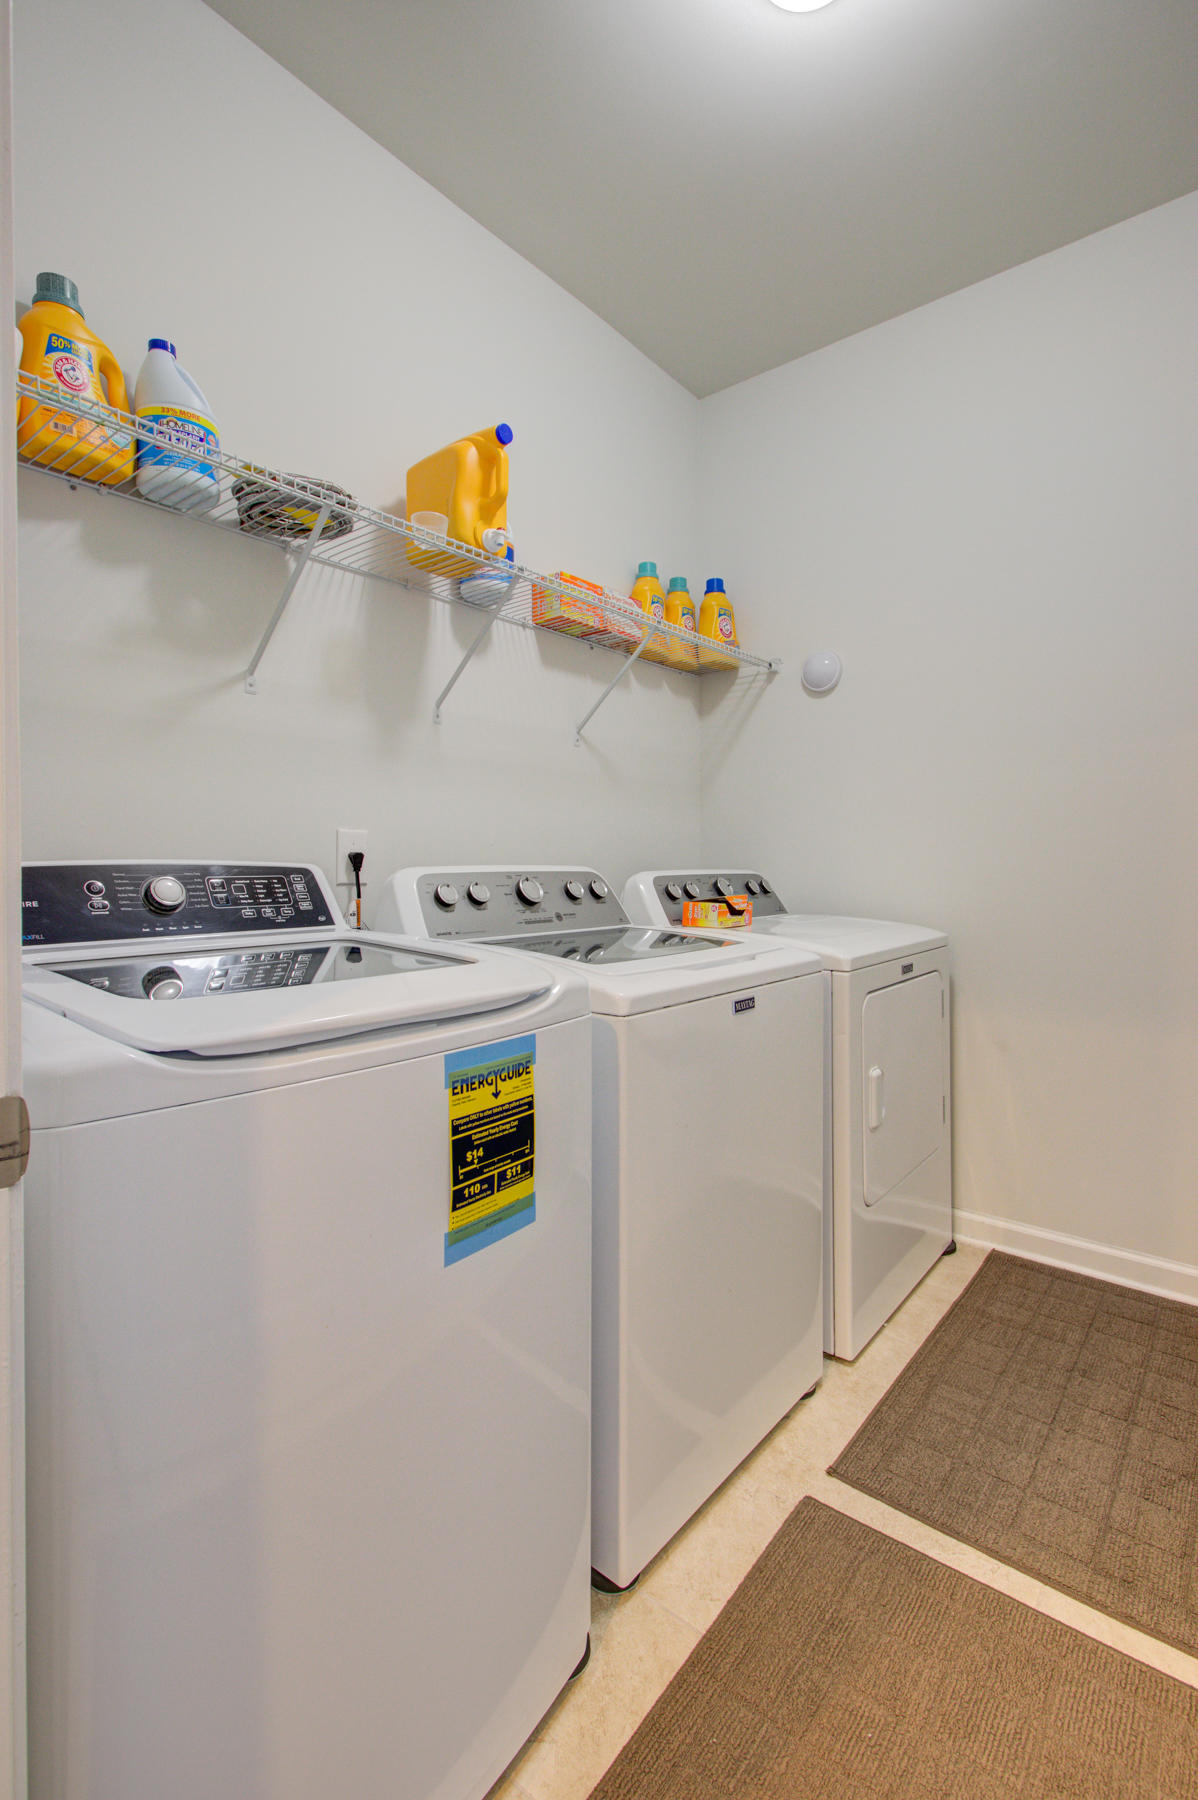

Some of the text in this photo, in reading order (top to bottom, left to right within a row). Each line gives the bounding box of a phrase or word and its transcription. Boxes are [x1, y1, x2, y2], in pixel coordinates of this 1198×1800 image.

[51, 335, 71, 349] 50%
[466, 1146, 484, 1163] $14
[506, 1165, 521, 1179] $11
[464, 1183, 481, 1198] 110
